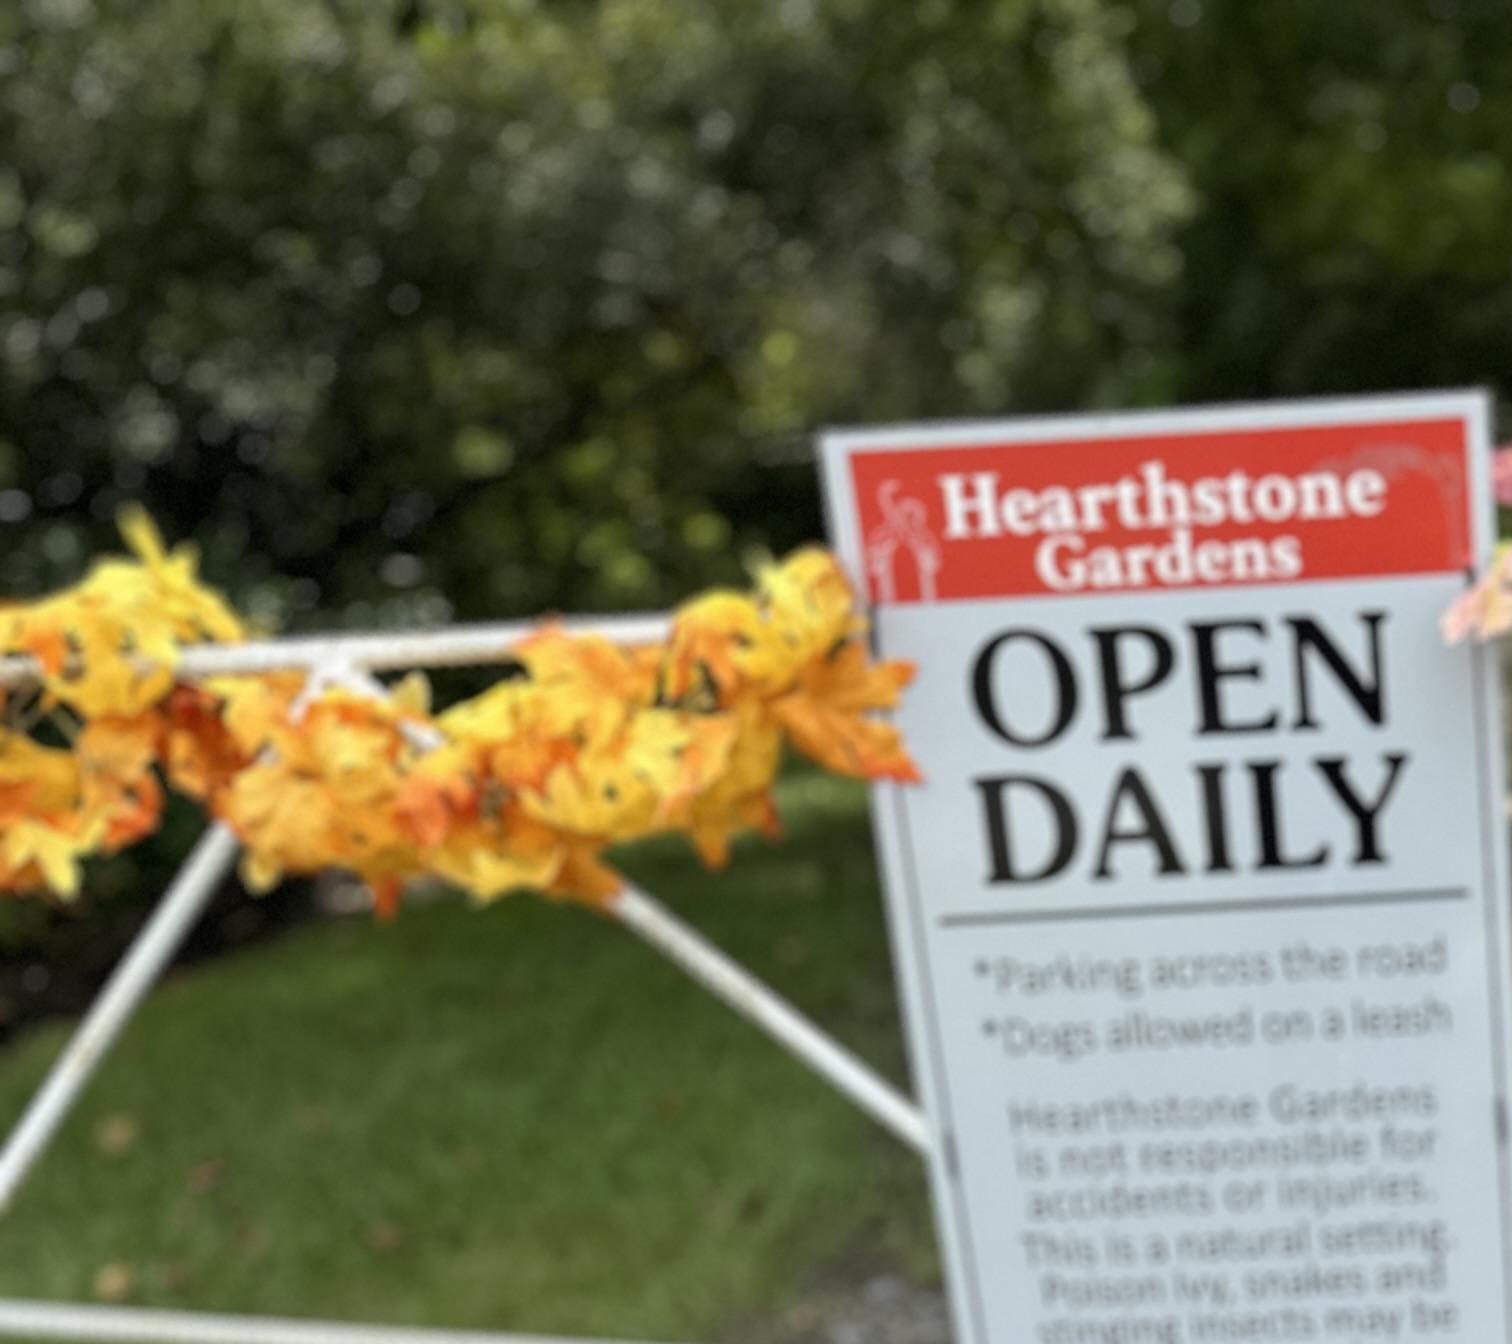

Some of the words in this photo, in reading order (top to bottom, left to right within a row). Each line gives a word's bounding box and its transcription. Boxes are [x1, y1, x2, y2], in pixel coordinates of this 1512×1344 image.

[938, 462, 1387, 539] Hearthstone
[1035, 527, 1302, 592] Gardens
[970, 611, 1389, 748] OPEN
[973, 751, 1408, 886] DAILY
[1152, 953, 1273, 987] across
[1284, 941, 1347, 980] the
[1361, 937, 1446, 975] road
[1109, 1007, 1252, 1049] allowed
[1265, 1012, 1311, 1042] on
[1322, 1011, 1342, 1038] a
[1354, 998, 1451, 1036] leash
[1011, 1096, 1257, 1134] Hearthstone
[1272, 1082, 1437, 1123] Gardens
[1062, 1144, 1124, 1175] not
[1141, 1133, 1367, 1173] responsible
[1383, 1126, 1436, 1160] for
[1029, 1186, 1213, 1221] accidents
[1226, 1183, 1264, 1213] or
[1280, 1171, 1435, 1214] injuries.
[1022, 1231, 1097, 1268] This
[1107, 1230, 1136, 1266] is
[1147, 1236, 1167, 1264] a
[1179, 1221, 1310, 1260] natural
[1320, 1221, 1455, 1258] setting.
[1042, 1273, 1165, 1307] Poison
[1245, 1263, 1366, 1302] snakes
[1378, 1259, 1445, 1292] and
[1190, 1309, 1316, 1343] insects
[1326, 1305, 1403, 1341] may
[1413, 1299, 1458, 1331] be
